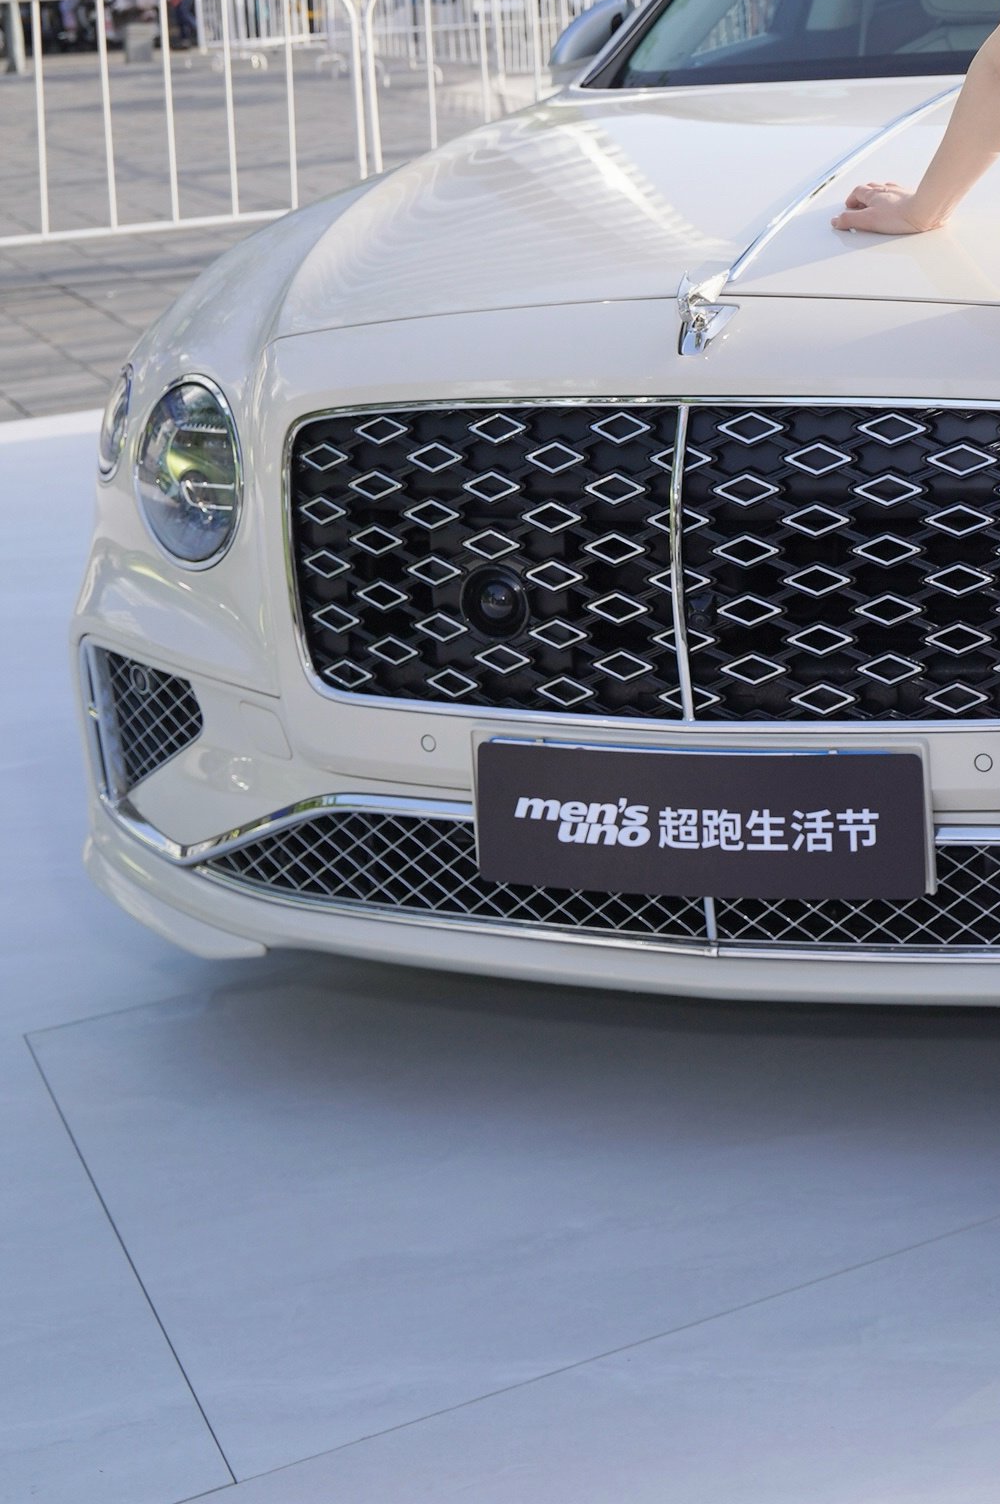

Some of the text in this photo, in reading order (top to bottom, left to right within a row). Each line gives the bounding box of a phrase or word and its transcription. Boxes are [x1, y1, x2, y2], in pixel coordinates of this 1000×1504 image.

[514, 796, 650, 826] men's
[557, 821, 651, 847] uno
[658, 806, 880, 853] 超跑生活节
